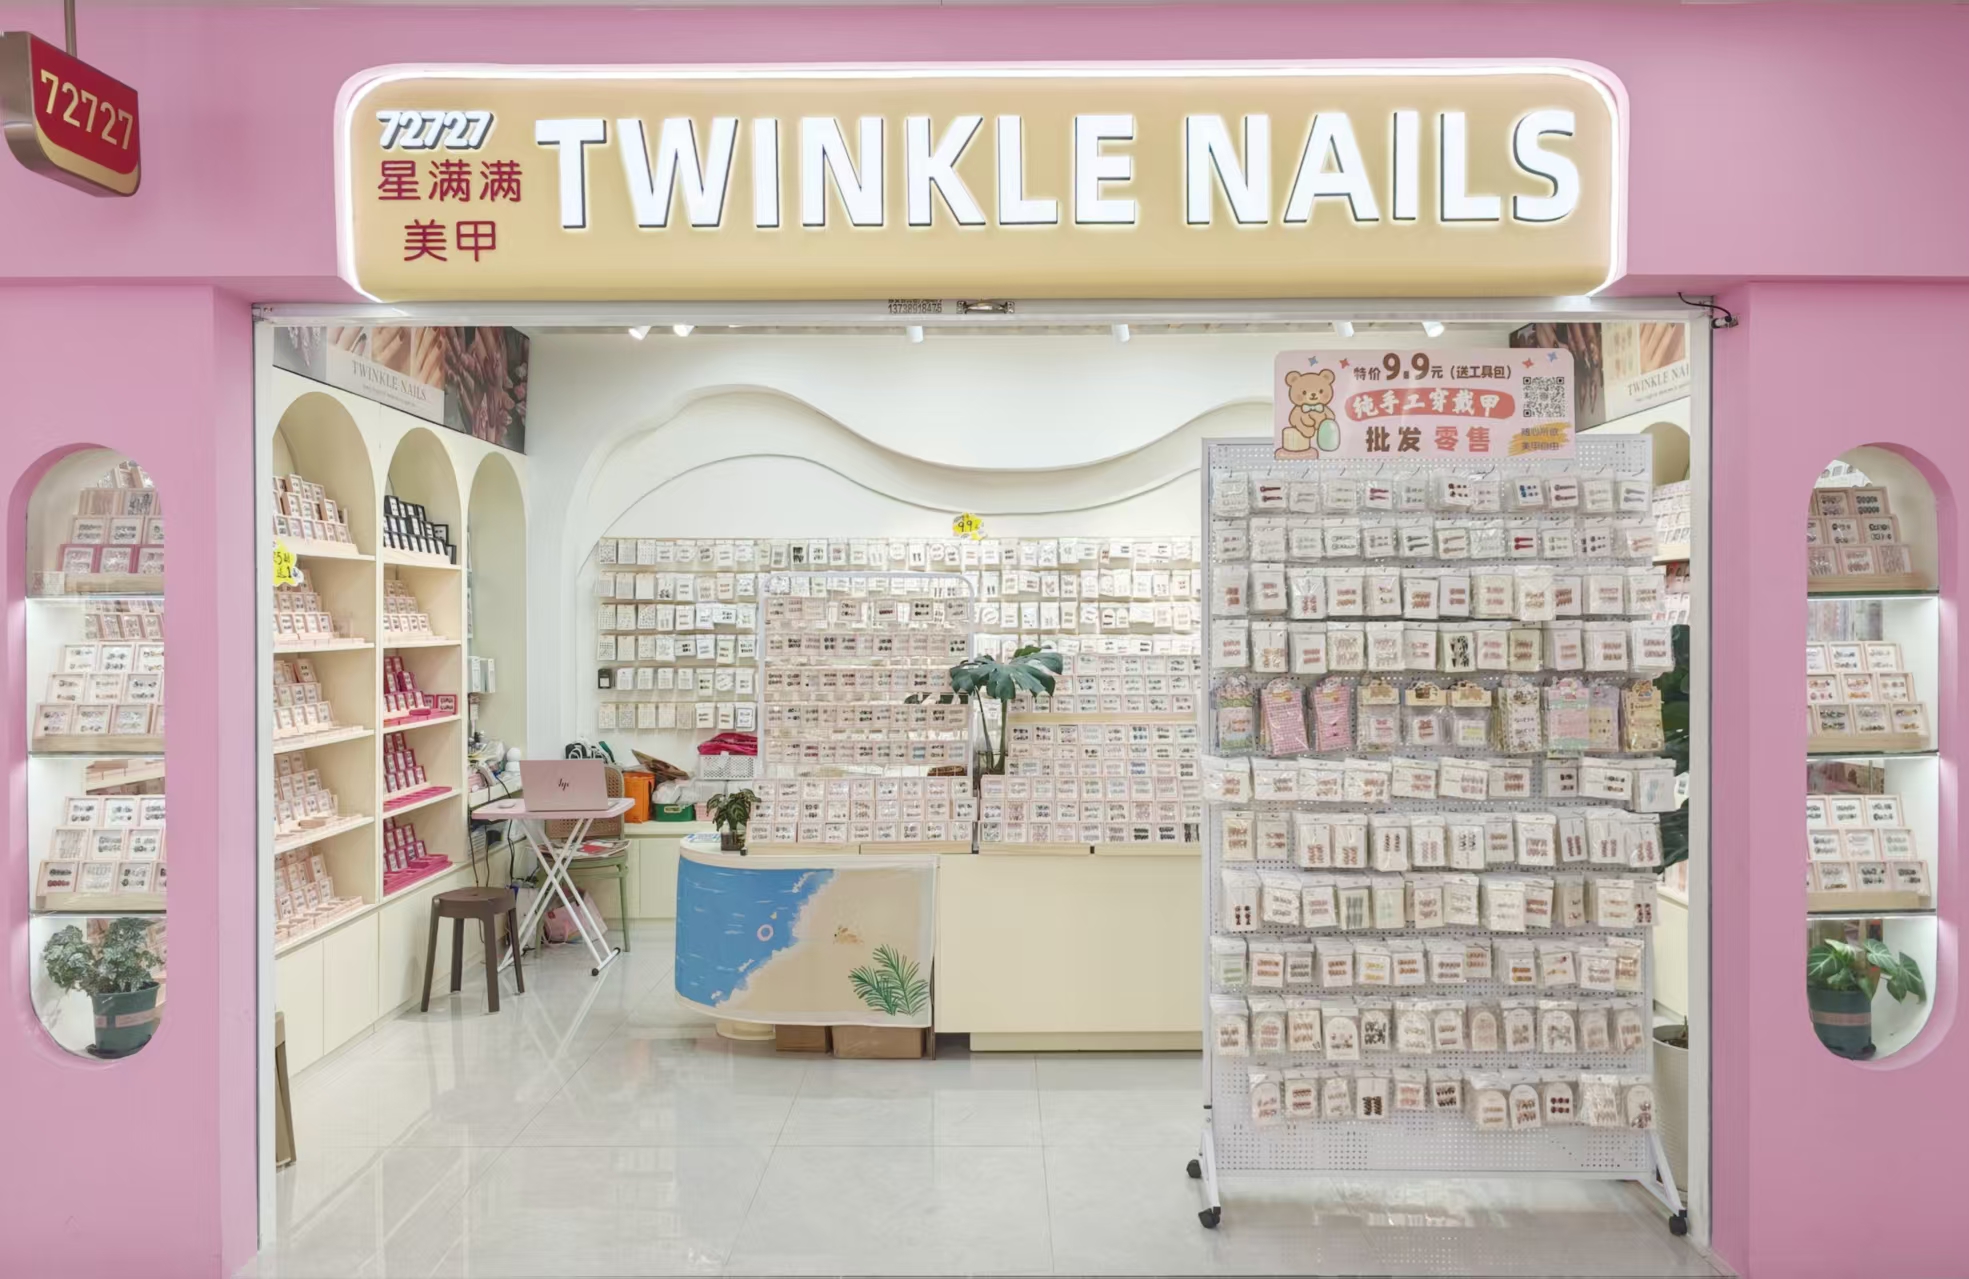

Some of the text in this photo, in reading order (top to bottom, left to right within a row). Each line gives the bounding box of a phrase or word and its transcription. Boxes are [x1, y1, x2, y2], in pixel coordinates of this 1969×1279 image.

[41, 68, 134, 150] 72727
[376, 110, 494, 150] 72727
[377, 159, 523, 202] 星满满
[534, 110, 1580, 227] TWINKLE NAILS
[403, 219, 497, 262] 美甲
[353, 361, 398, 390] TWINKLE
[400, 379, 427, 401] NAILS
[1627, 371, 1669, 397] TWINKLE
[1352, 388, 1500, 418] 纯手工穿戴甲
[1366, 426, 1491, 452] 批发 零售
[558, 778, 569, 791] hp
